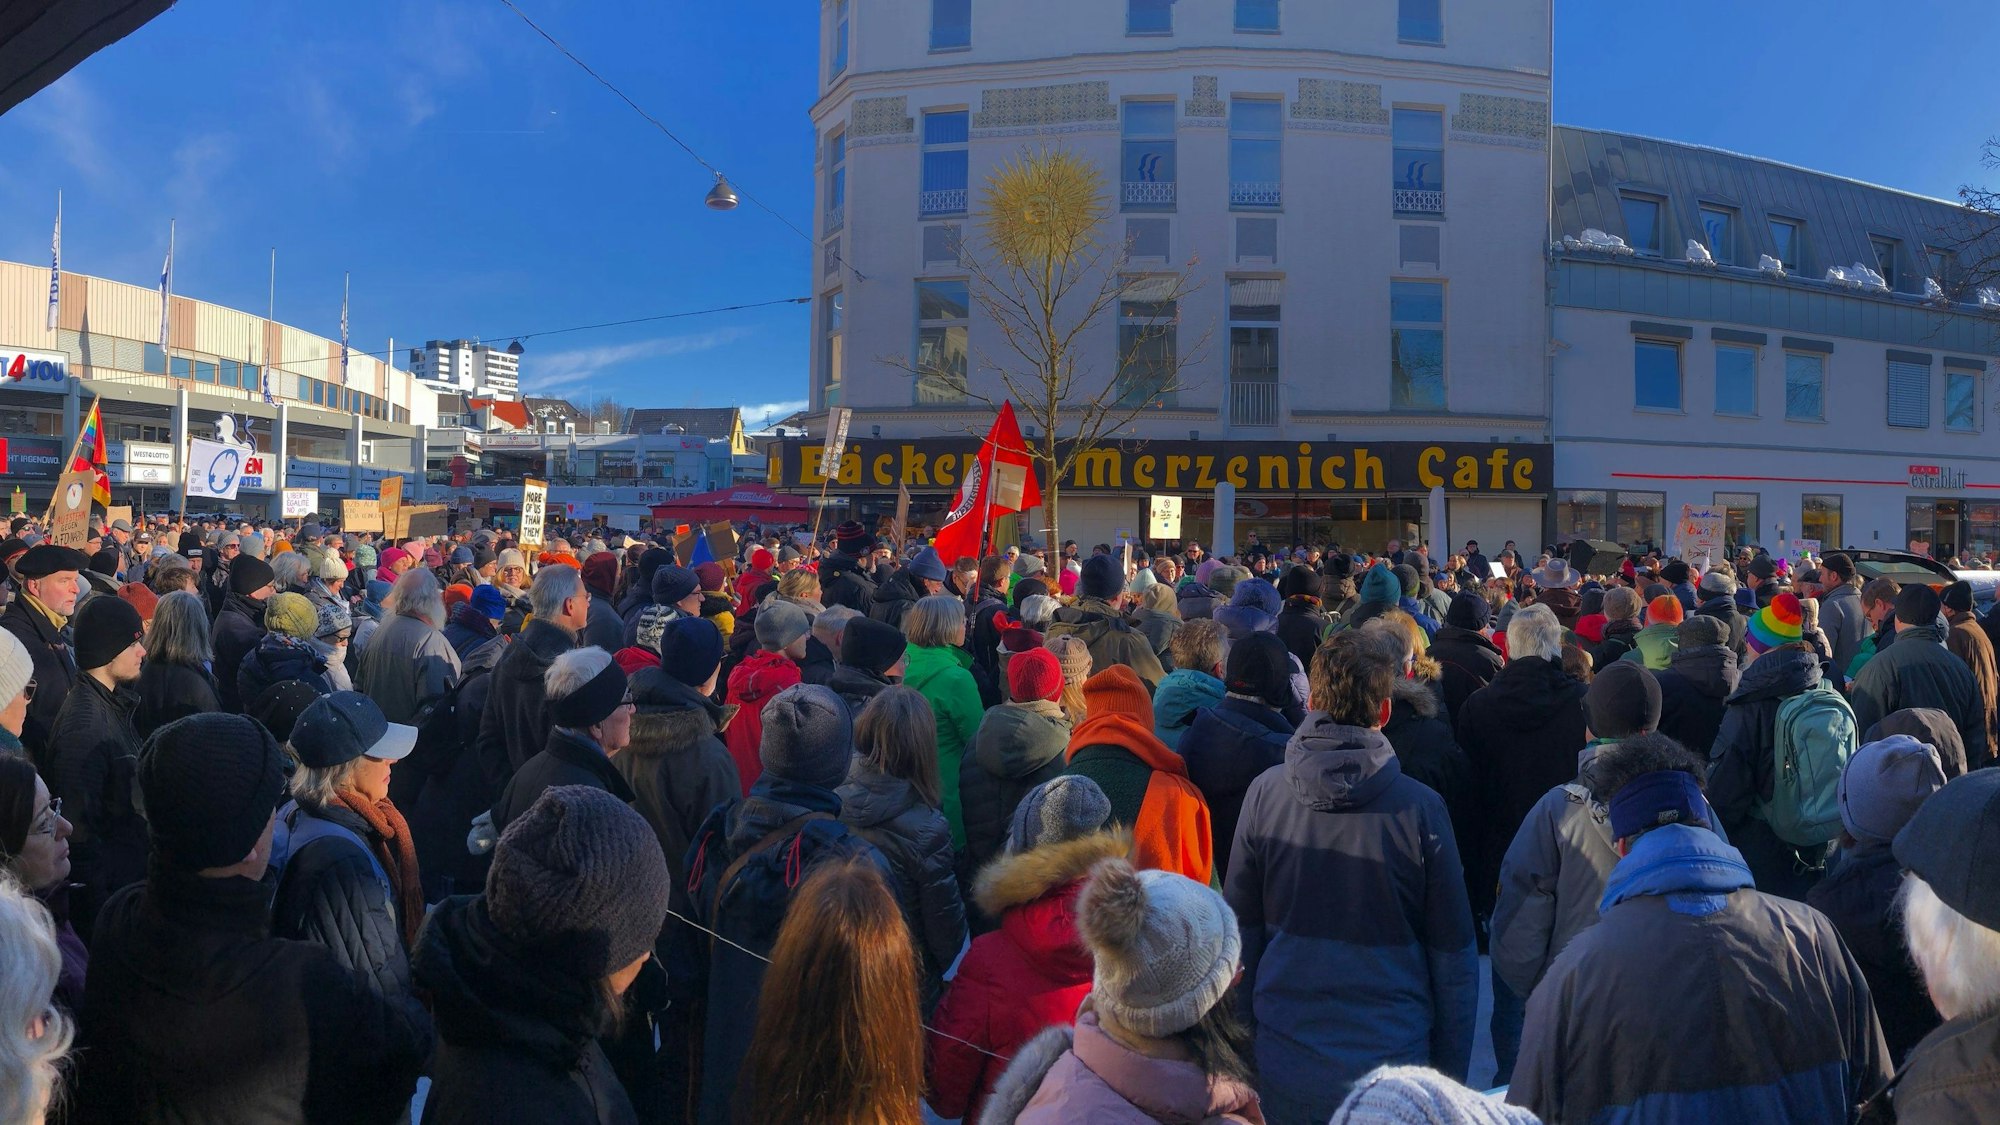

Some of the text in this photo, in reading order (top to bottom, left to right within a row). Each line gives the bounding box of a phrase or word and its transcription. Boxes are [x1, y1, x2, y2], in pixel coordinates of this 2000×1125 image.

[8, 354, 26, 382] 4
[26, 360, 64, 382] YOU
[1418, 446, 1534, 490] Cafe
[526, 491, 543, 503] MORE
[525, 503, 533, 513] OF
[533, 503, 542, 514] US
[524, 515, 541, 525] THAN
[60, 521, 79, 532] GEGEN
[523, 527, 541, 538] THEM
